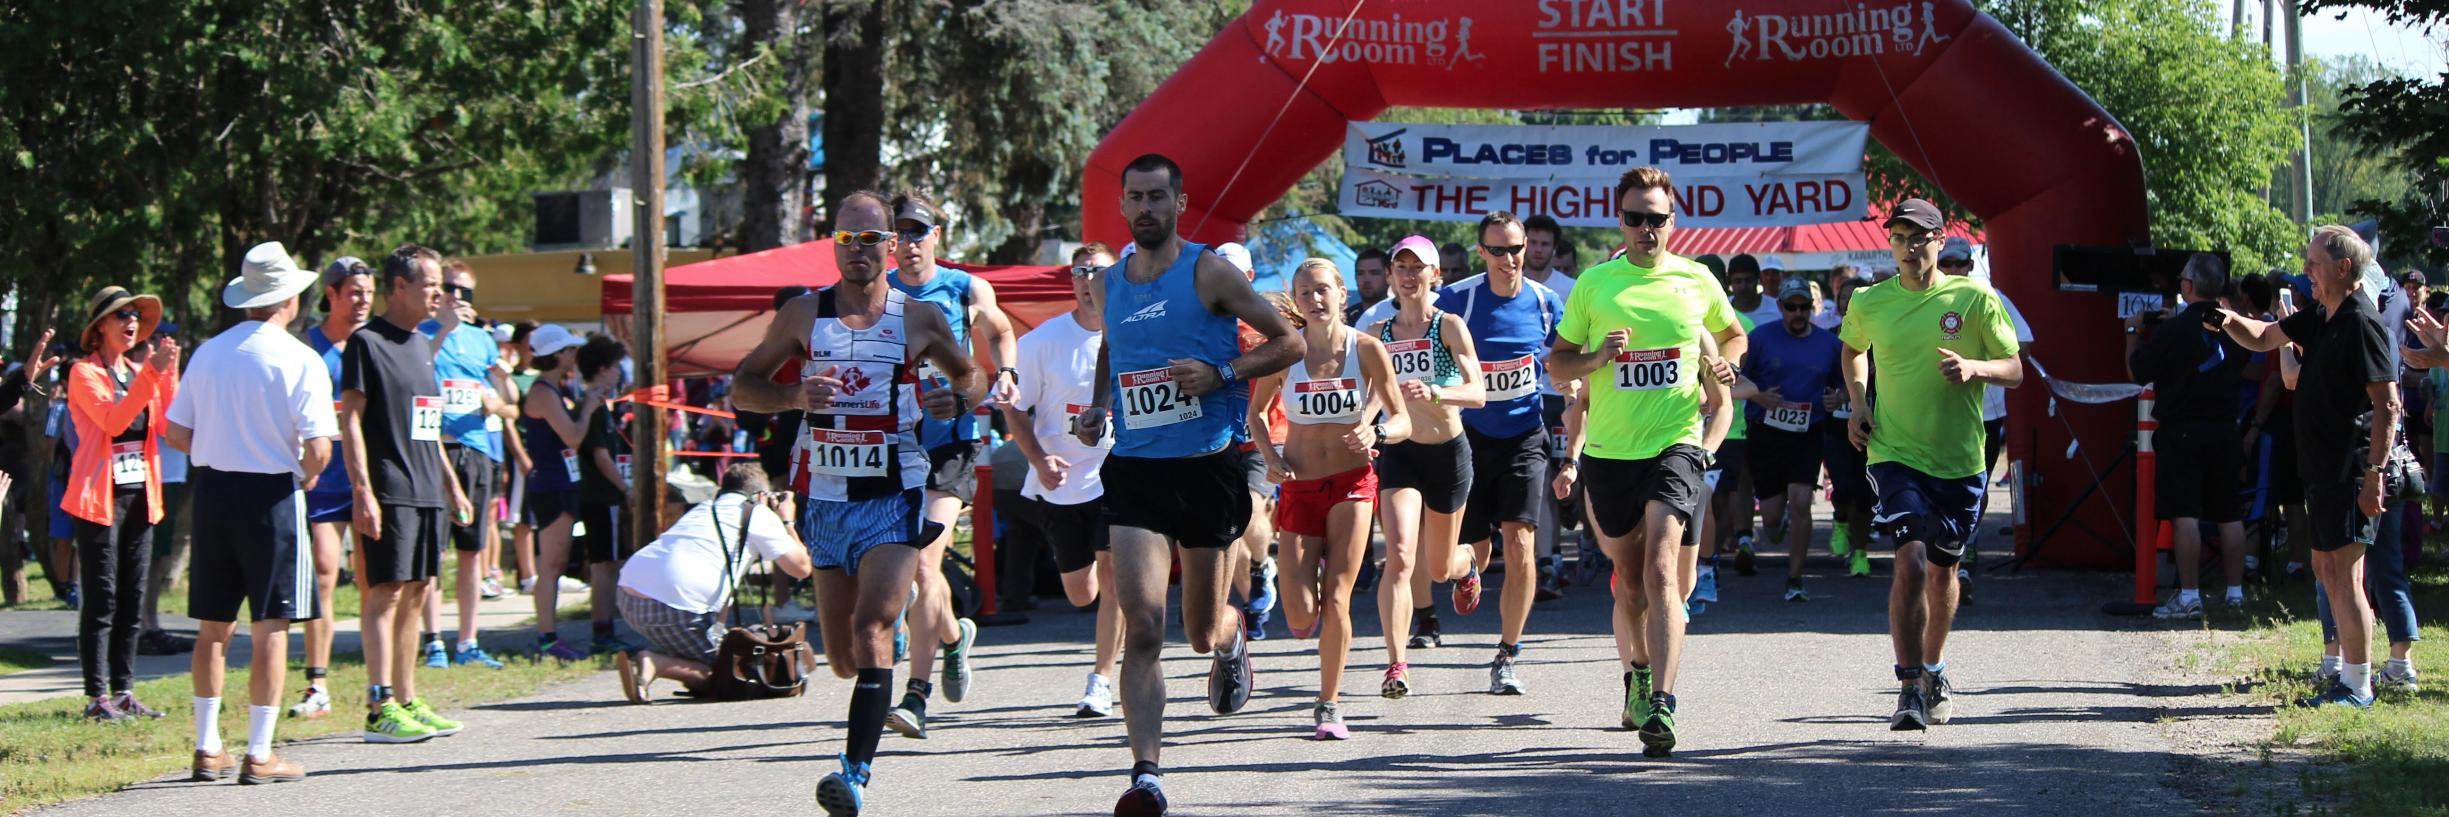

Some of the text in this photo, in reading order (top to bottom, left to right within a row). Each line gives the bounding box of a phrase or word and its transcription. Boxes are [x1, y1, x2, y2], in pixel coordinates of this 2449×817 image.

[1538, 0, 1664, 28] START
[1288, 13, 1448, 59] Running
[1755, 3, 1913, 60] Running
[1538, 41, 1672, 73] FINISH
[1423, 137, 1793, 165] PLACES for PEOPLE
[1410, 179, 1852, 219] THE HIGHND YARD
[1120, 310, 1166, 323] ALTRA
[2122, 294, 2158, 316] 10K
[1392, 350, 1430, 375] 036
[1620, 361, 1678, 387] 1003
[1485, 366, 1531, 392] 1022
[1127, 383, 1193, 416] 1024
[1299, 391, 1357, 416] 1004
[419, 409, 441, 429] 12
[1179, 410, 1198, 421] 1024
[1770, 408, 1807, 425] 1023
[816, 444, 882, 468] 1014
